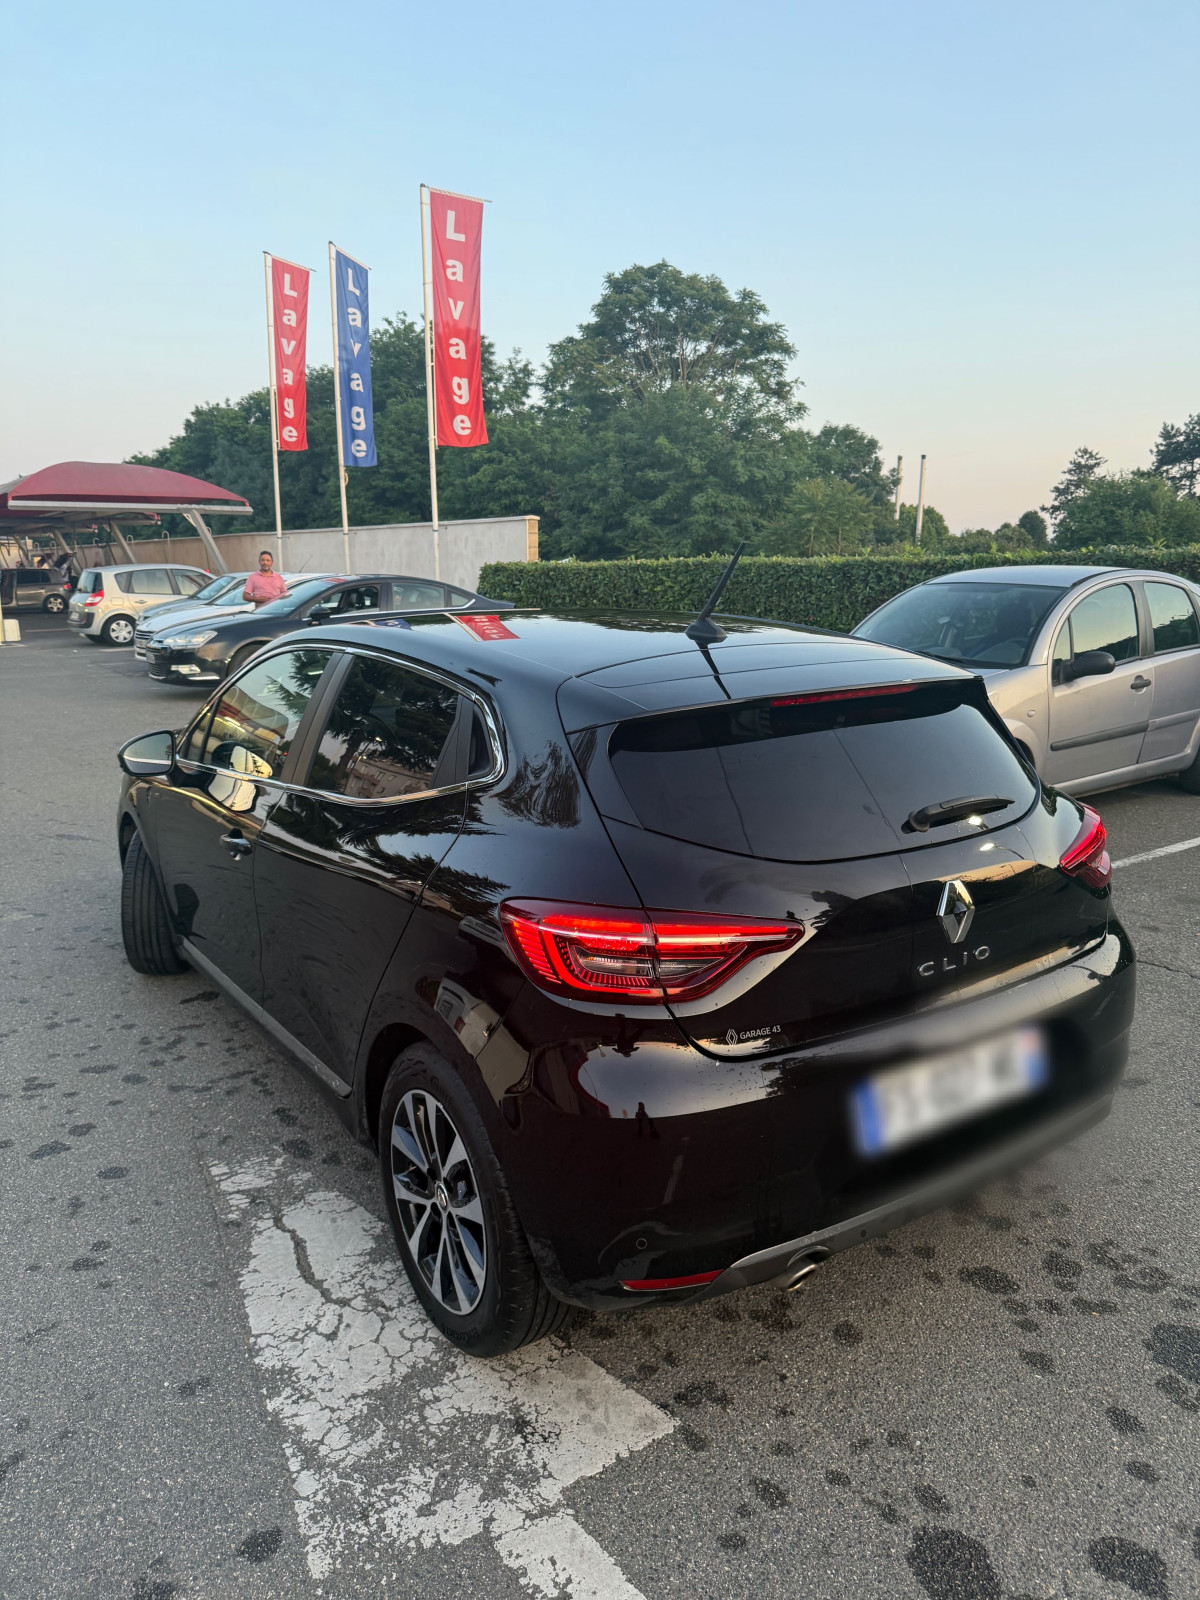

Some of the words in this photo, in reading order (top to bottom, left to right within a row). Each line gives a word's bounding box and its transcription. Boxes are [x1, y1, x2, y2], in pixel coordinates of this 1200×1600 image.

[281, 273, 298, 442] Lavage
[346, 268, 367, 458] Lavage
[445, 210, 472, 436] Lavage
[739, 1026, 771, 1040] GARAGE
[772, 1024, 782, 1034] 43
[918, 945, 991, 977] CLIO
